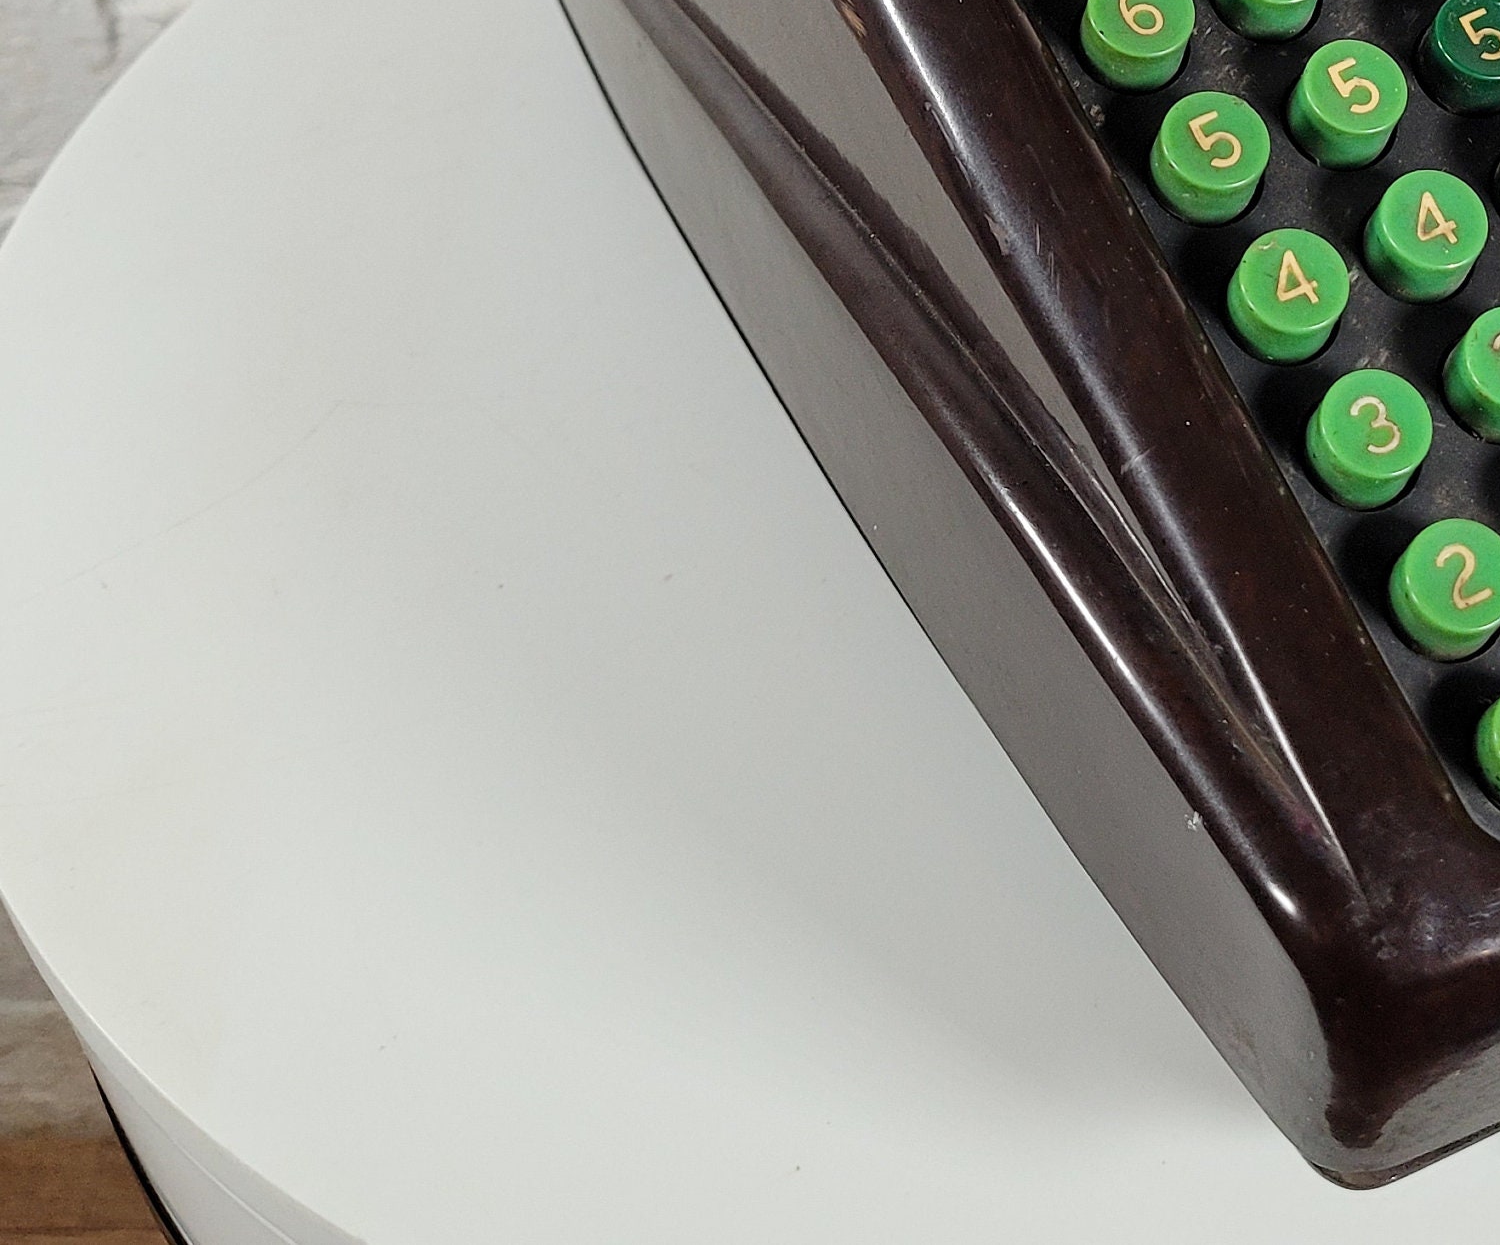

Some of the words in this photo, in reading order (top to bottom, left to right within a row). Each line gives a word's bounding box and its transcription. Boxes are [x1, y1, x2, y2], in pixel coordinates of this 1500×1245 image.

[1327, 58, 1380, 114] 5
[1188, 111, 1243, 168] 5
[1416, 191, 1458, 245] 4
[1276, 250, 1319, 304] 4
[1350, 396, 1401, 454] 3
[1435, 542, 1493, 610] 2
